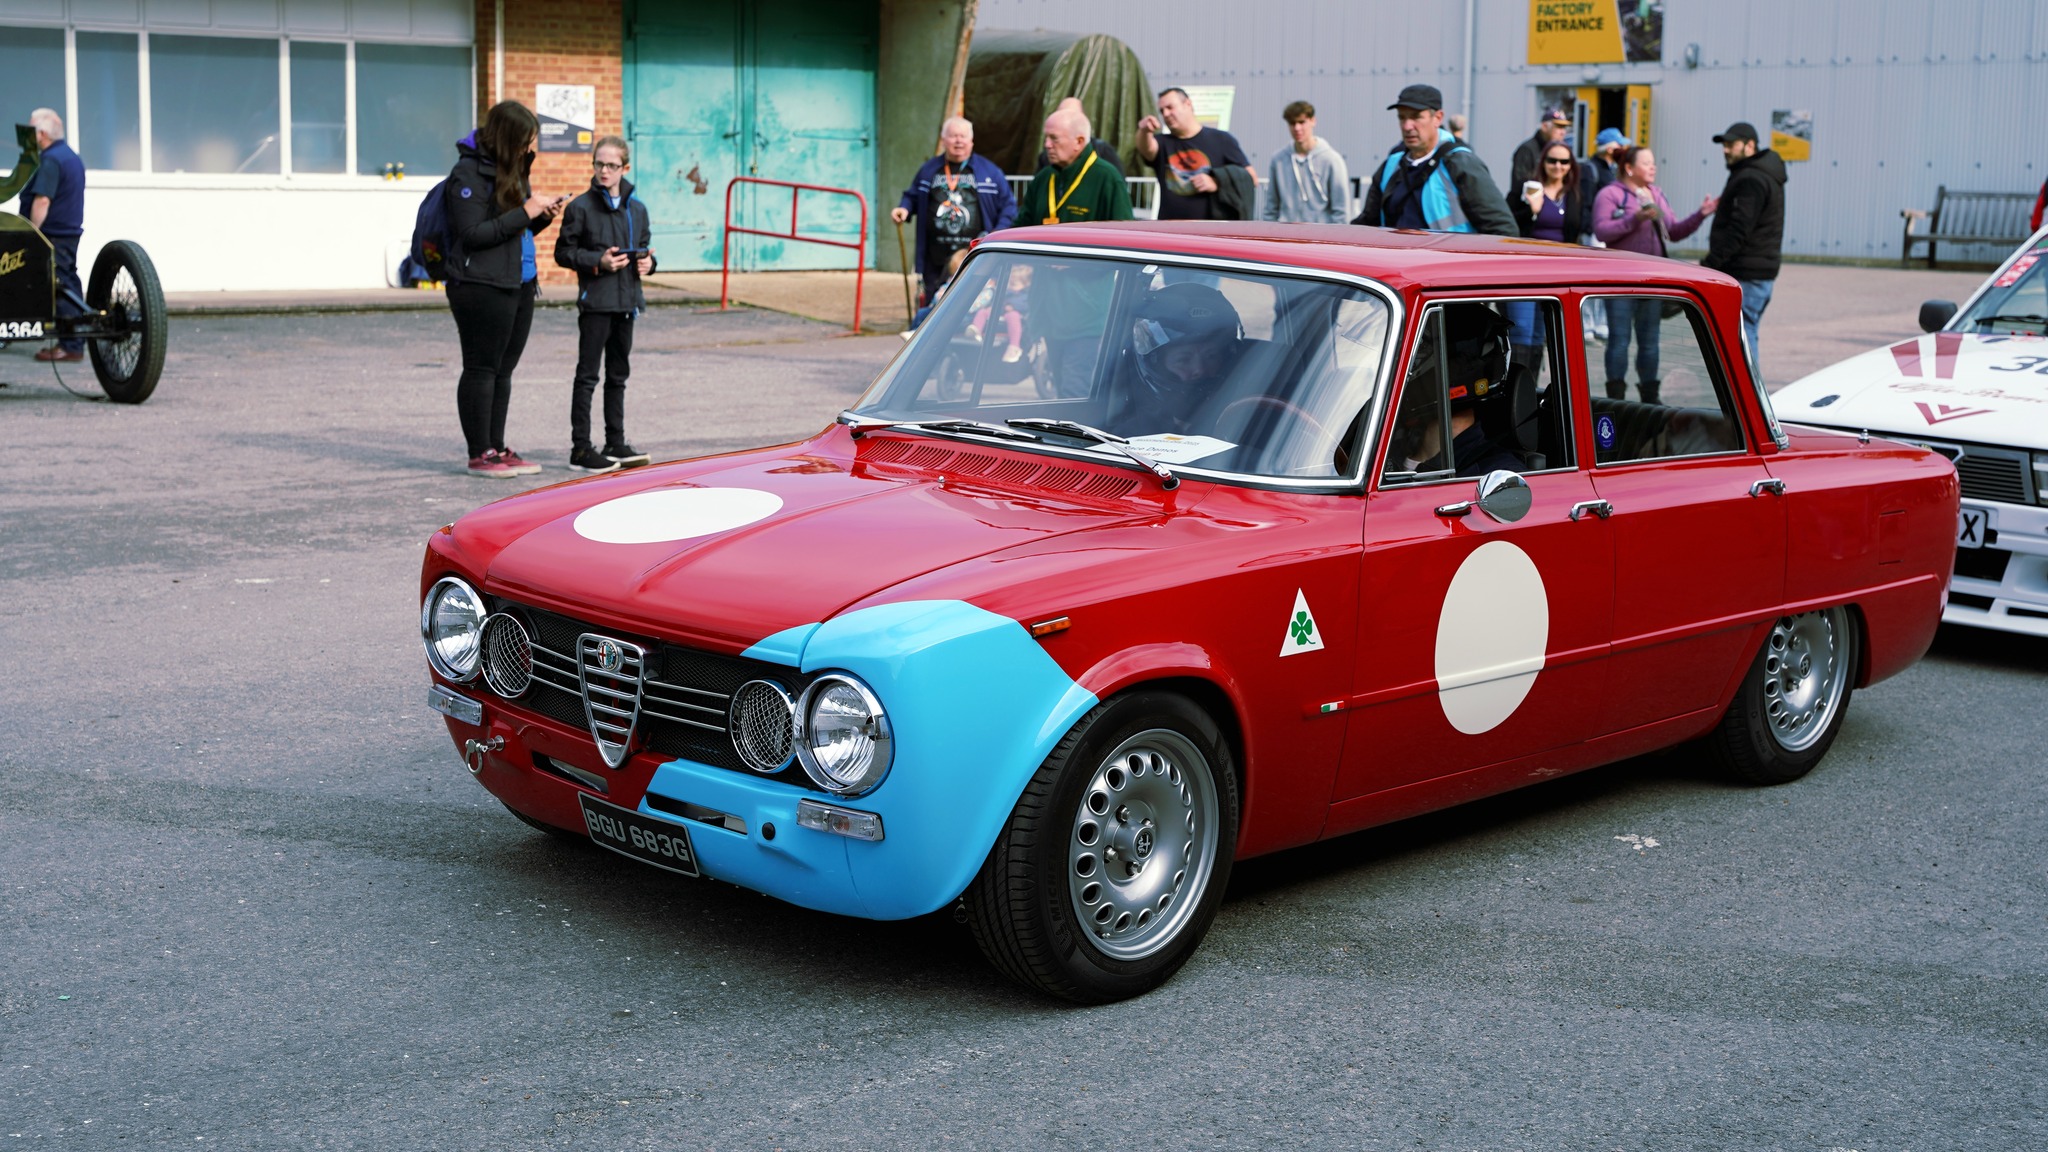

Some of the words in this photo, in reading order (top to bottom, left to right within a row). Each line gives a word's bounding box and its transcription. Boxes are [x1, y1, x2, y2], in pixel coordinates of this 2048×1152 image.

[1536, 2, 1595, 16] FACTORY
[1536, 17, 1604, 32] ENTRANCE
[0, 321, 44, 337] 4364
[1960, 513, 1979, 542] X
[585, 808, 626, 842] BGU
[629, 825, 690, 862] 683G
